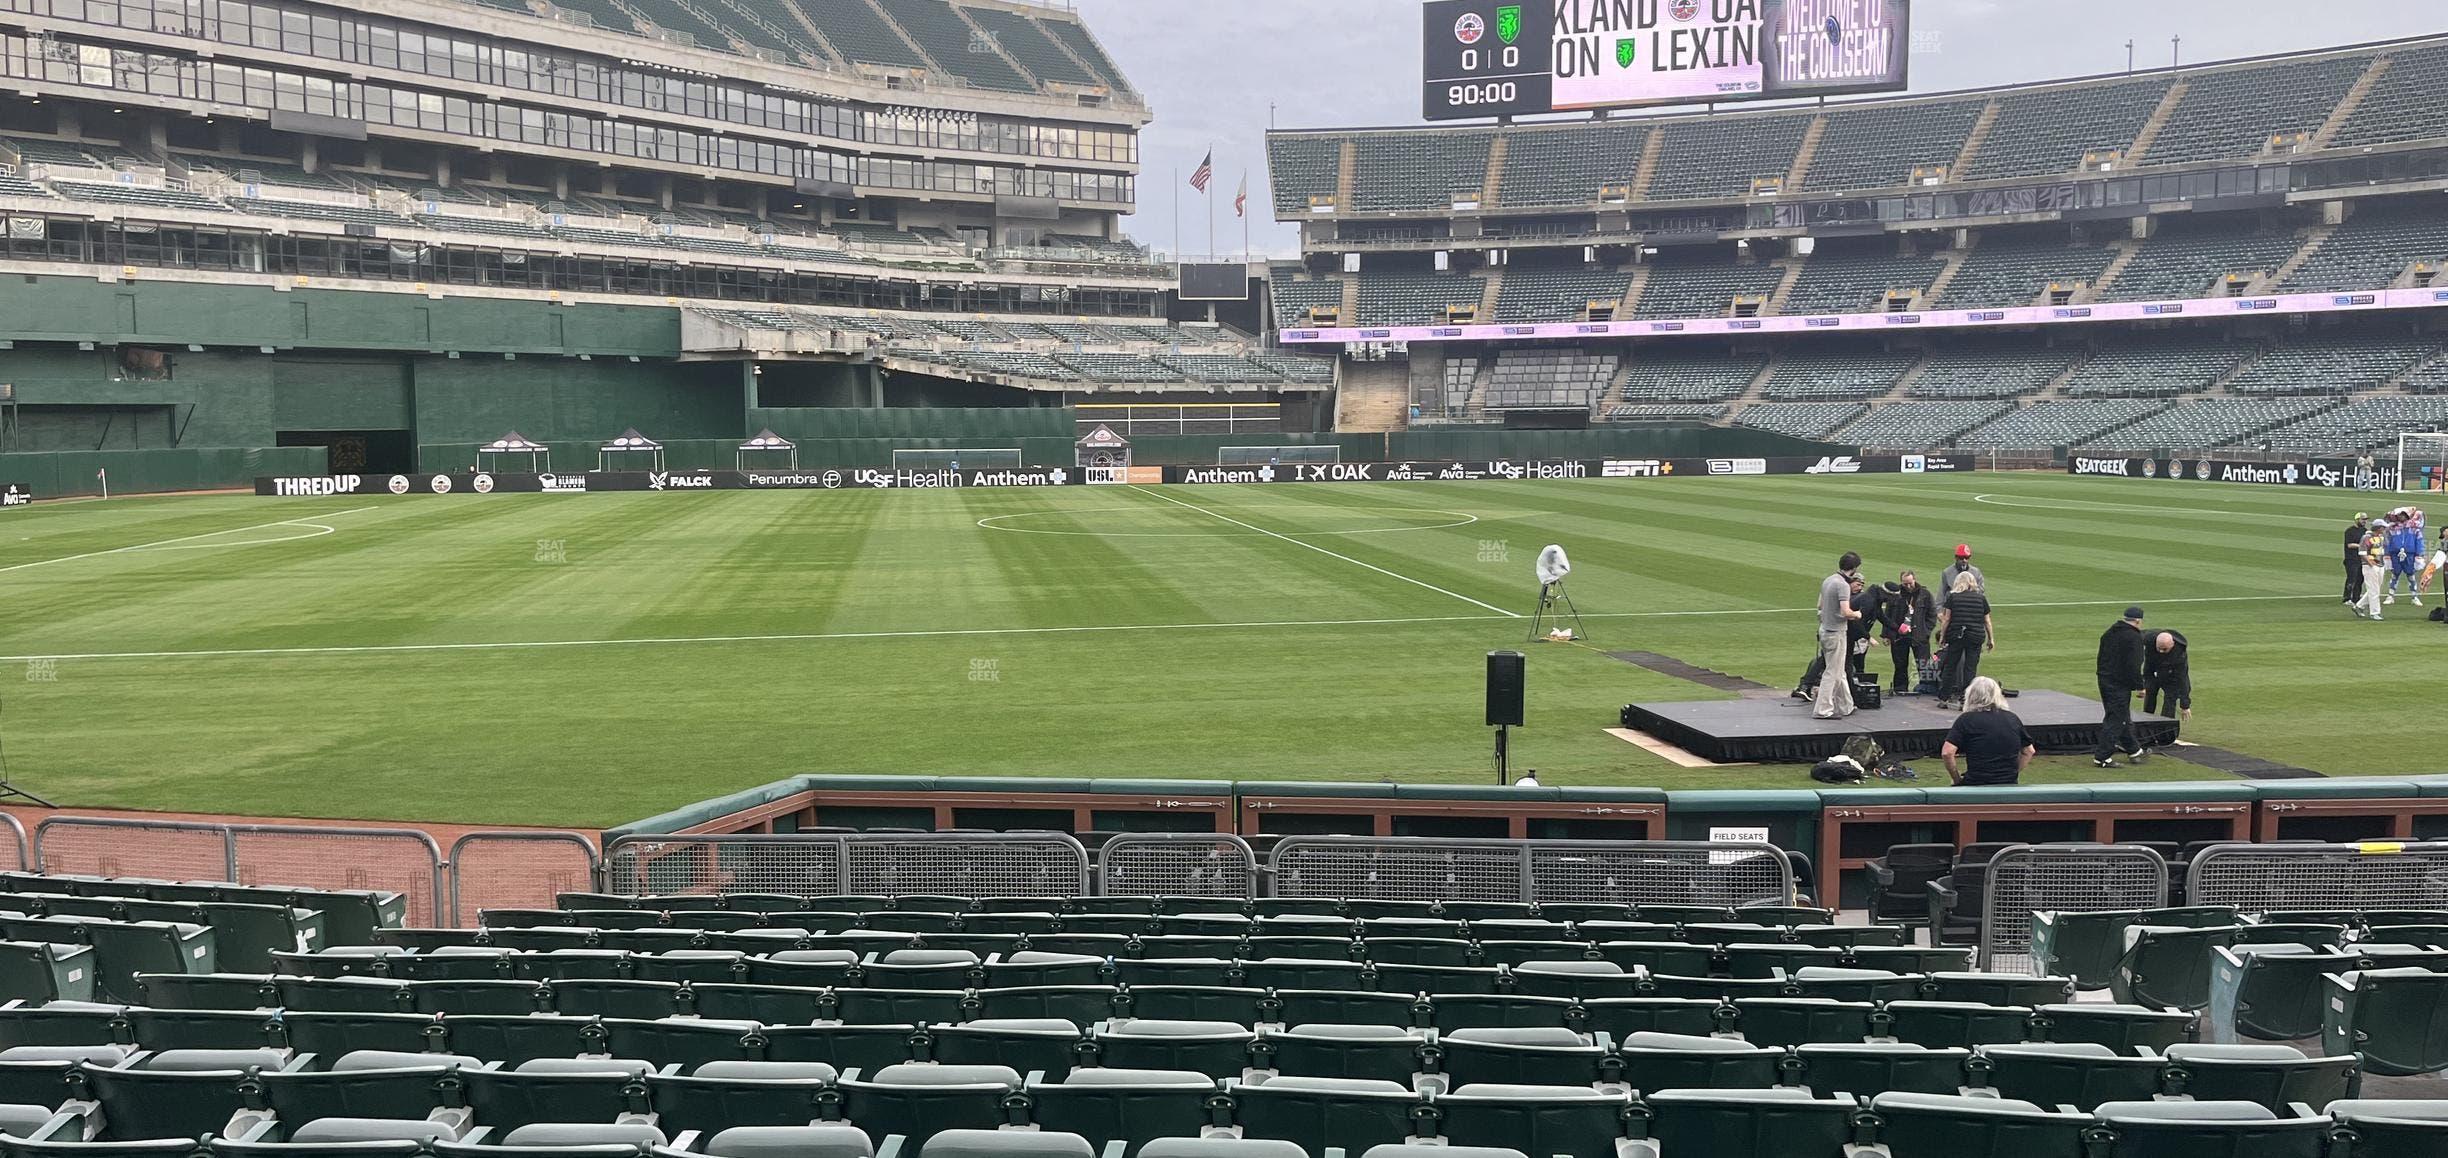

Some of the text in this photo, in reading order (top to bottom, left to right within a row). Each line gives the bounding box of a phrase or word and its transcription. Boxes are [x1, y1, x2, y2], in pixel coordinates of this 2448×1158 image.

[1462, 46, 1519, 70] 0 0
[1552, 23, 1764, 78] ON LEXIN
[1778, 28, 1888, 82] THE COLISEUM
[1449, 82, 1516, 106] 90:00
[1088, 469, 1114, 482] USL
[1184, 468, 1255, 483] Anthem
[1295, 464, 1372, 481] I OAK
[1386, 470, 1411, 480] Ava
[1439, 469, 1463, 480] Ava
[1488, 460, 1586, 479] UCSF Health
[1601, 460, 1673, 477] ESPN+
[2075, 457, 2128, 476] SEATGEEK
[2221, 464, 2280, 483] Anthem
[2306, 464, 2340, 487] UCSF
[273, 474, 361, 496] THREDUP
[670, 476, 712, 487] FALCK
[749, 474, 817, 486] Penumbra
[854, 469, 963, 488] UCSF Health
[972, 470, 1044, 486] Anthem
[3, 492, 19, 506] Ava
